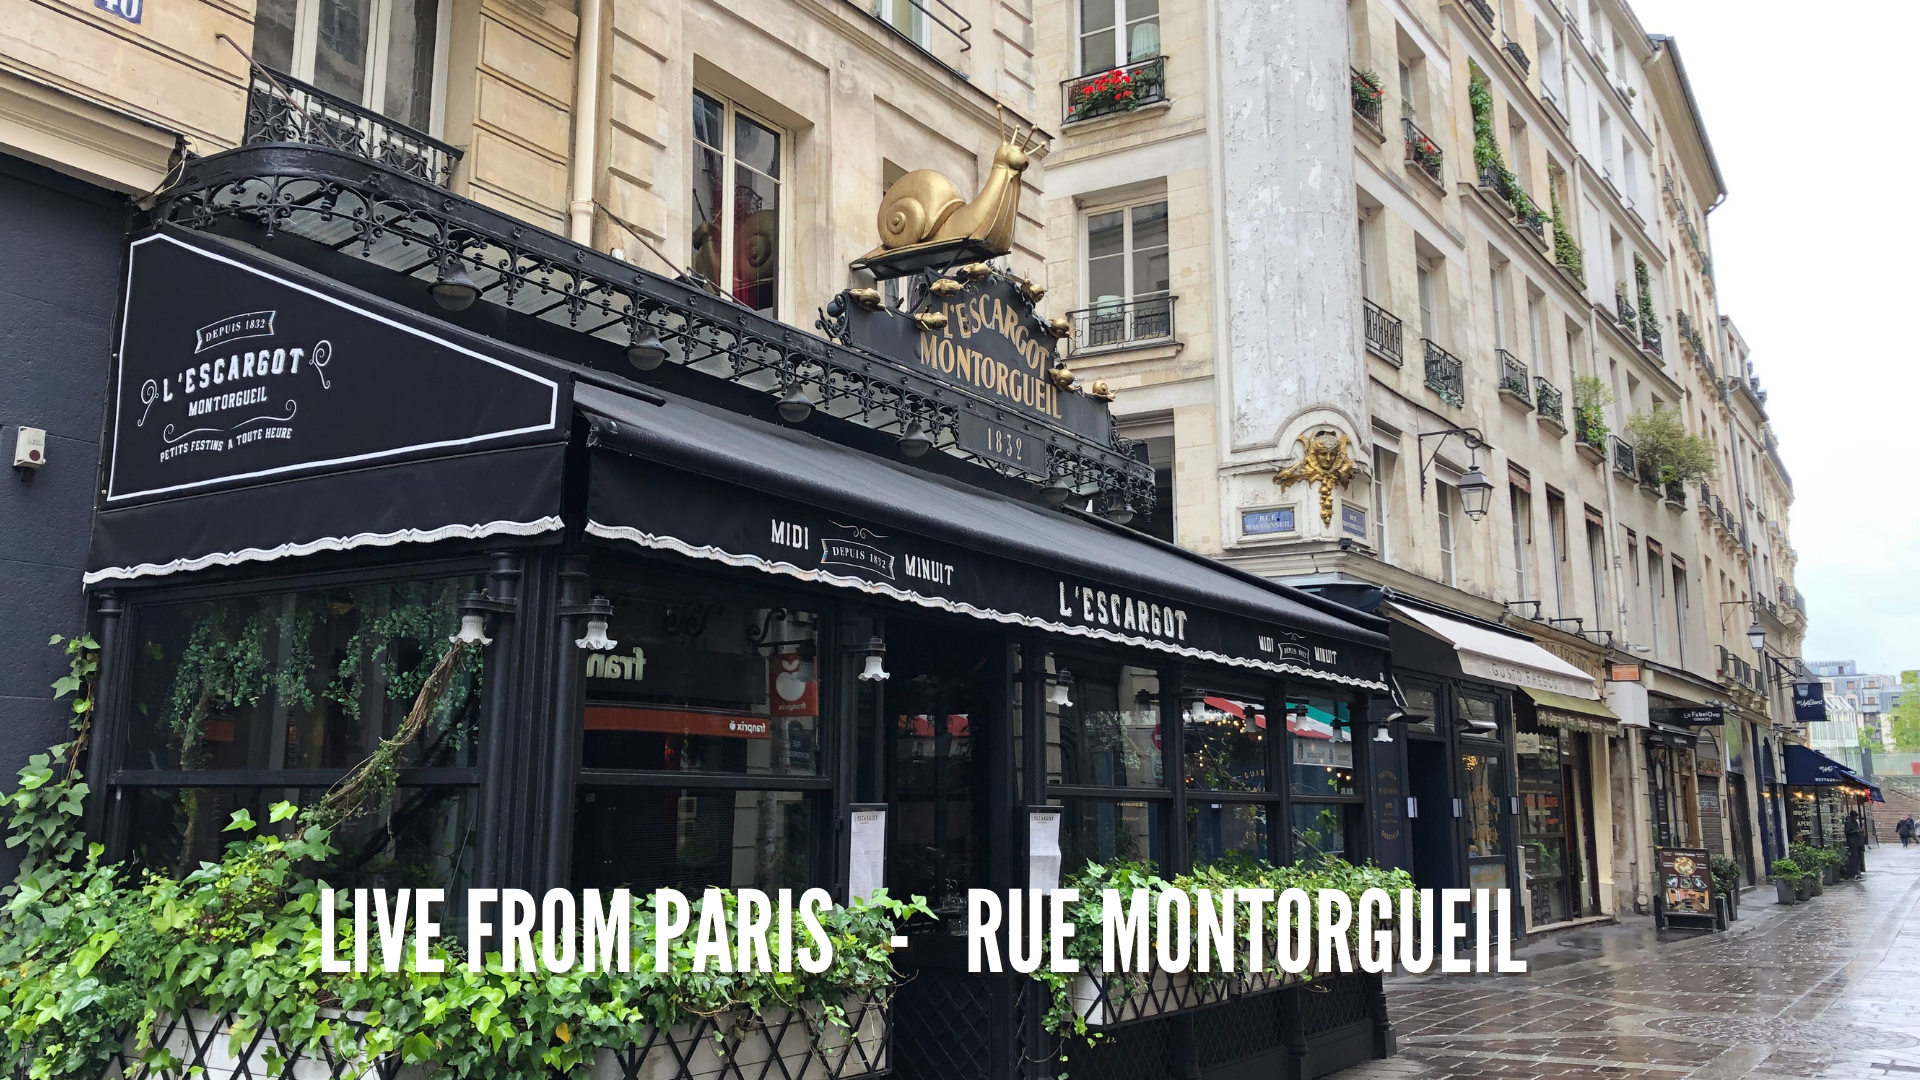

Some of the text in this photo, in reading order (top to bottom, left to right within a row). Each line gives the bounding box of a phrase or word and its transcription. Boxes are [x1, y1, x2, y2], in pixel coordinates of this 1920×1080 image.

[205, 318, 266, 342] DEPUIS 1832
[942, 294, 1050, 380] L'ESCARGOT
[163, 348, 304, 403] L'ESCARGOT
[919, 332, 1062, 420] MONTORGUEIL
[188, 386, 268, 417] MONTORGUEIL
[160, 427, 292, 462] PETITS FESTINS A TOUTE HEURE
[986, 427, 1022, 461] 1832
[1259, 513, 1277, 521] RUE
[771, 519, 954, 586] MIDI DEPUIS 1832 MINUIT
[1059, 581, 1188, 641] L'ESCARGOT
[1258, 634, 1274, 653] MIDI
[1314, 646, 1338, 665] MINUIT
[1491, 662, 1558, 690] GUSTO FRESCO
